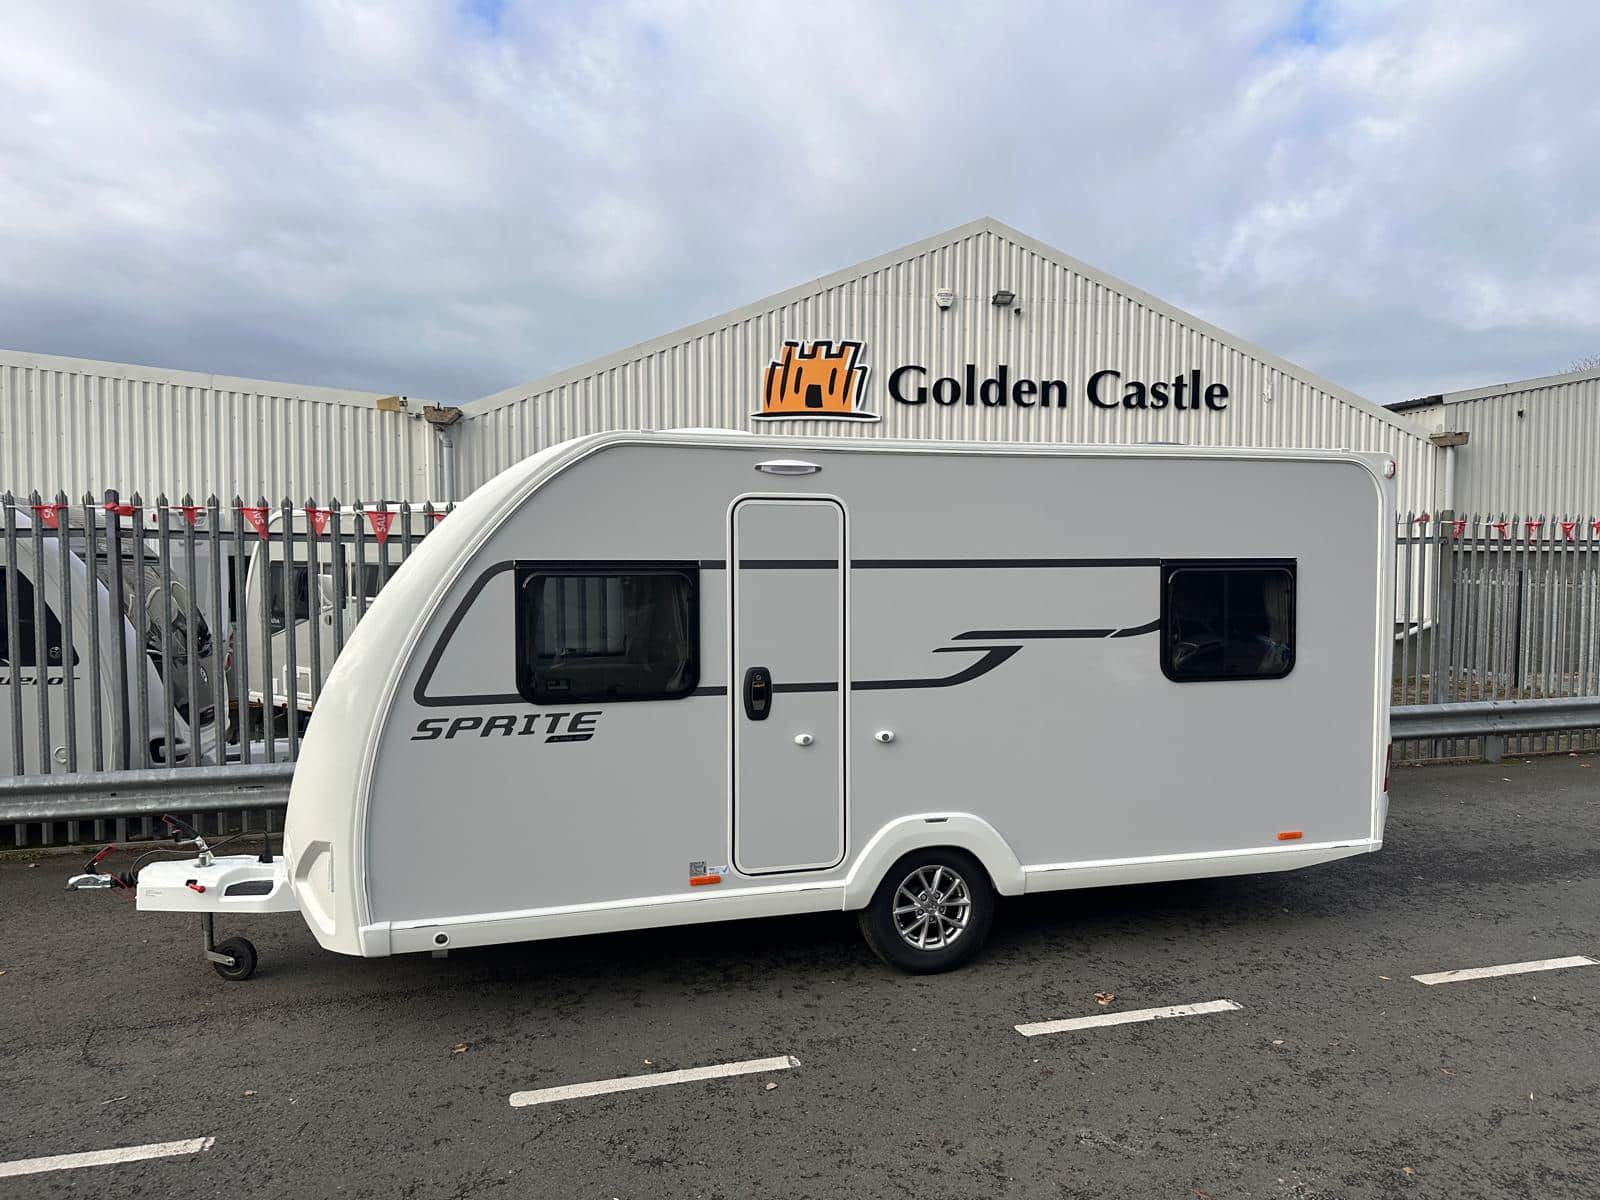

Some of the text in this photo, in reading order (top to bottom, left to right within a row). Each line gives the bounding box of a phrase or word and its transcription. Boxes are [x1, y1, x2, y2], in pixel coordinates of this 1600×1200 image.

[888, 364, 1229, 411] Golden Castle
[410, 711, 602, 741] SPRITE
